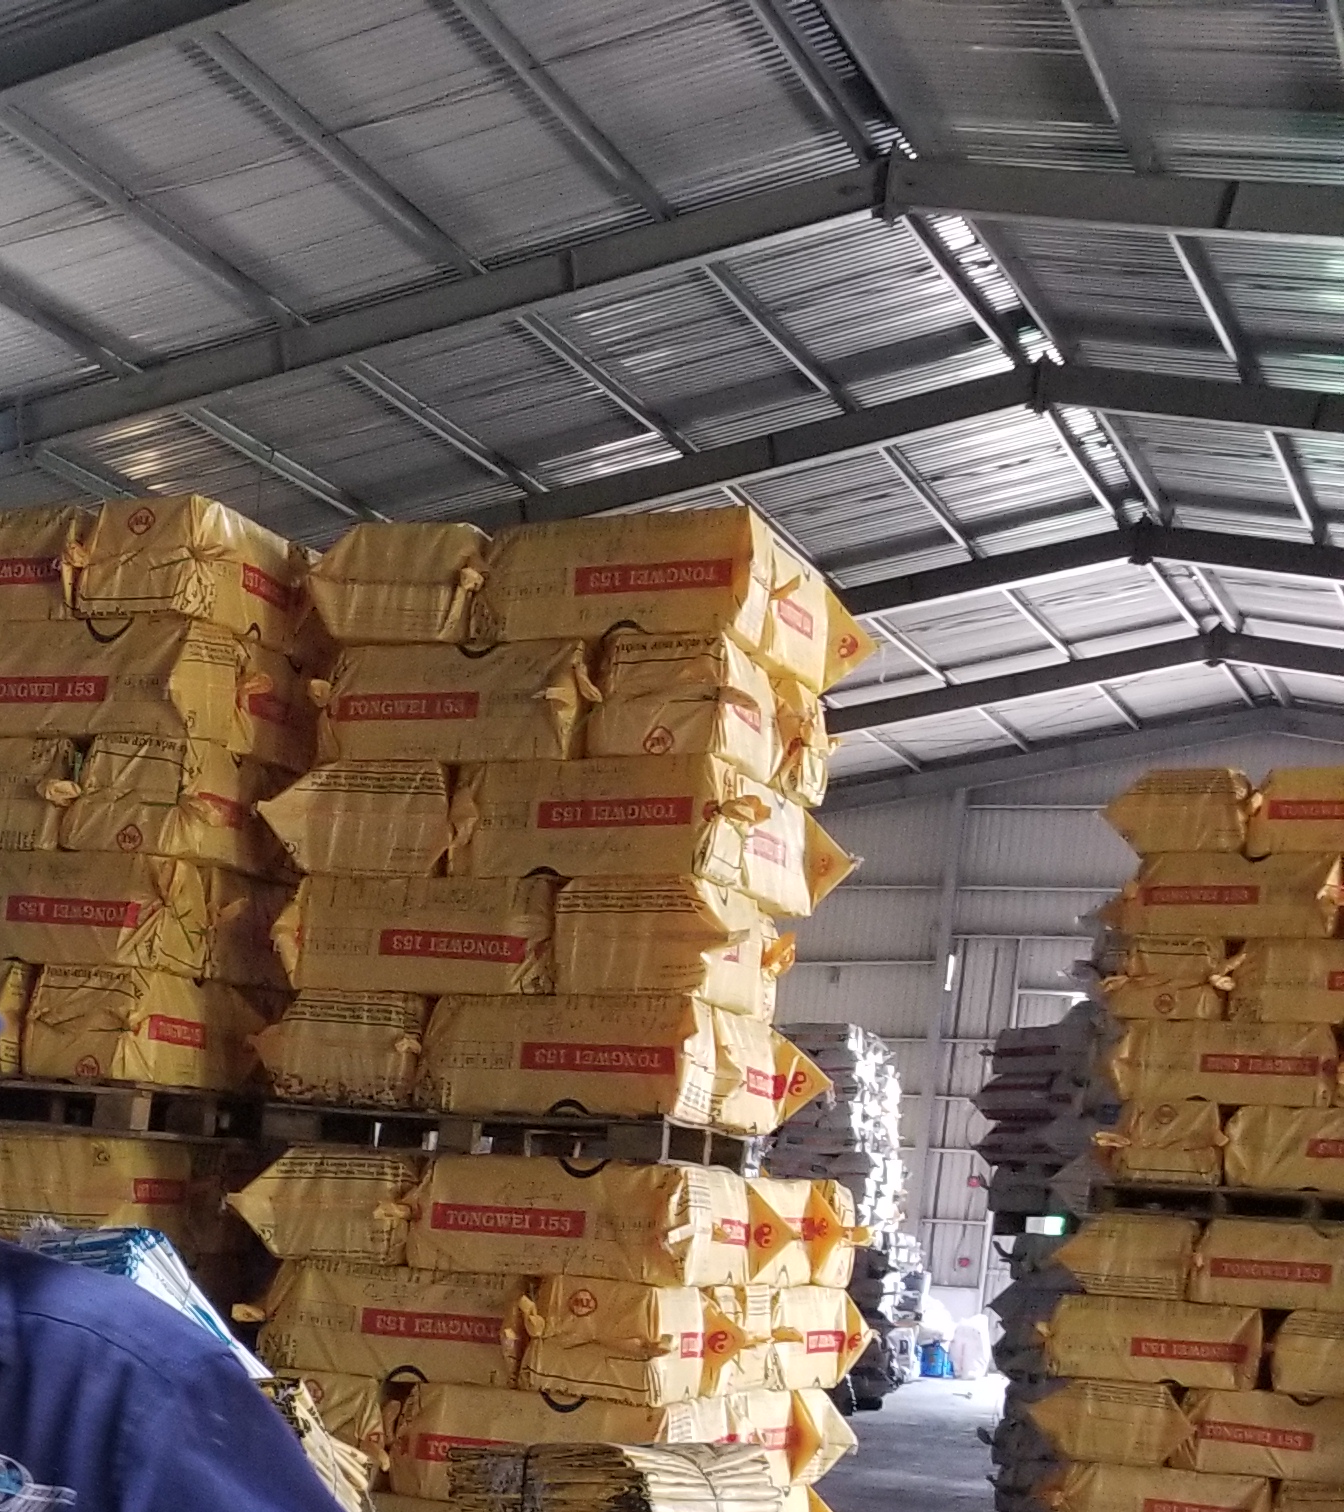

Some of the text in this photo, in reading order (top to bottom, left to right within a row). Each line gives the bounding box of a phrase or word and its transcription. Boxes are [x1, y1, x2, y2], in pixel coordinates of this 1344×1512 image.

[589, 563, 718, 589] TONGWEI 153
[64, 680, 96, 697] 153
[347, 699, 428, 716] TONGWEI
[550, 803, 677, 823] TONGWEI 153
[52, 902, 129, 924] TONGWEI
[428, 937, 512, 956] TONGWEI
[575, 1050, 662, 1067] TONGWEI
[445, 1209, 573, 1233] TONGWEI 153
